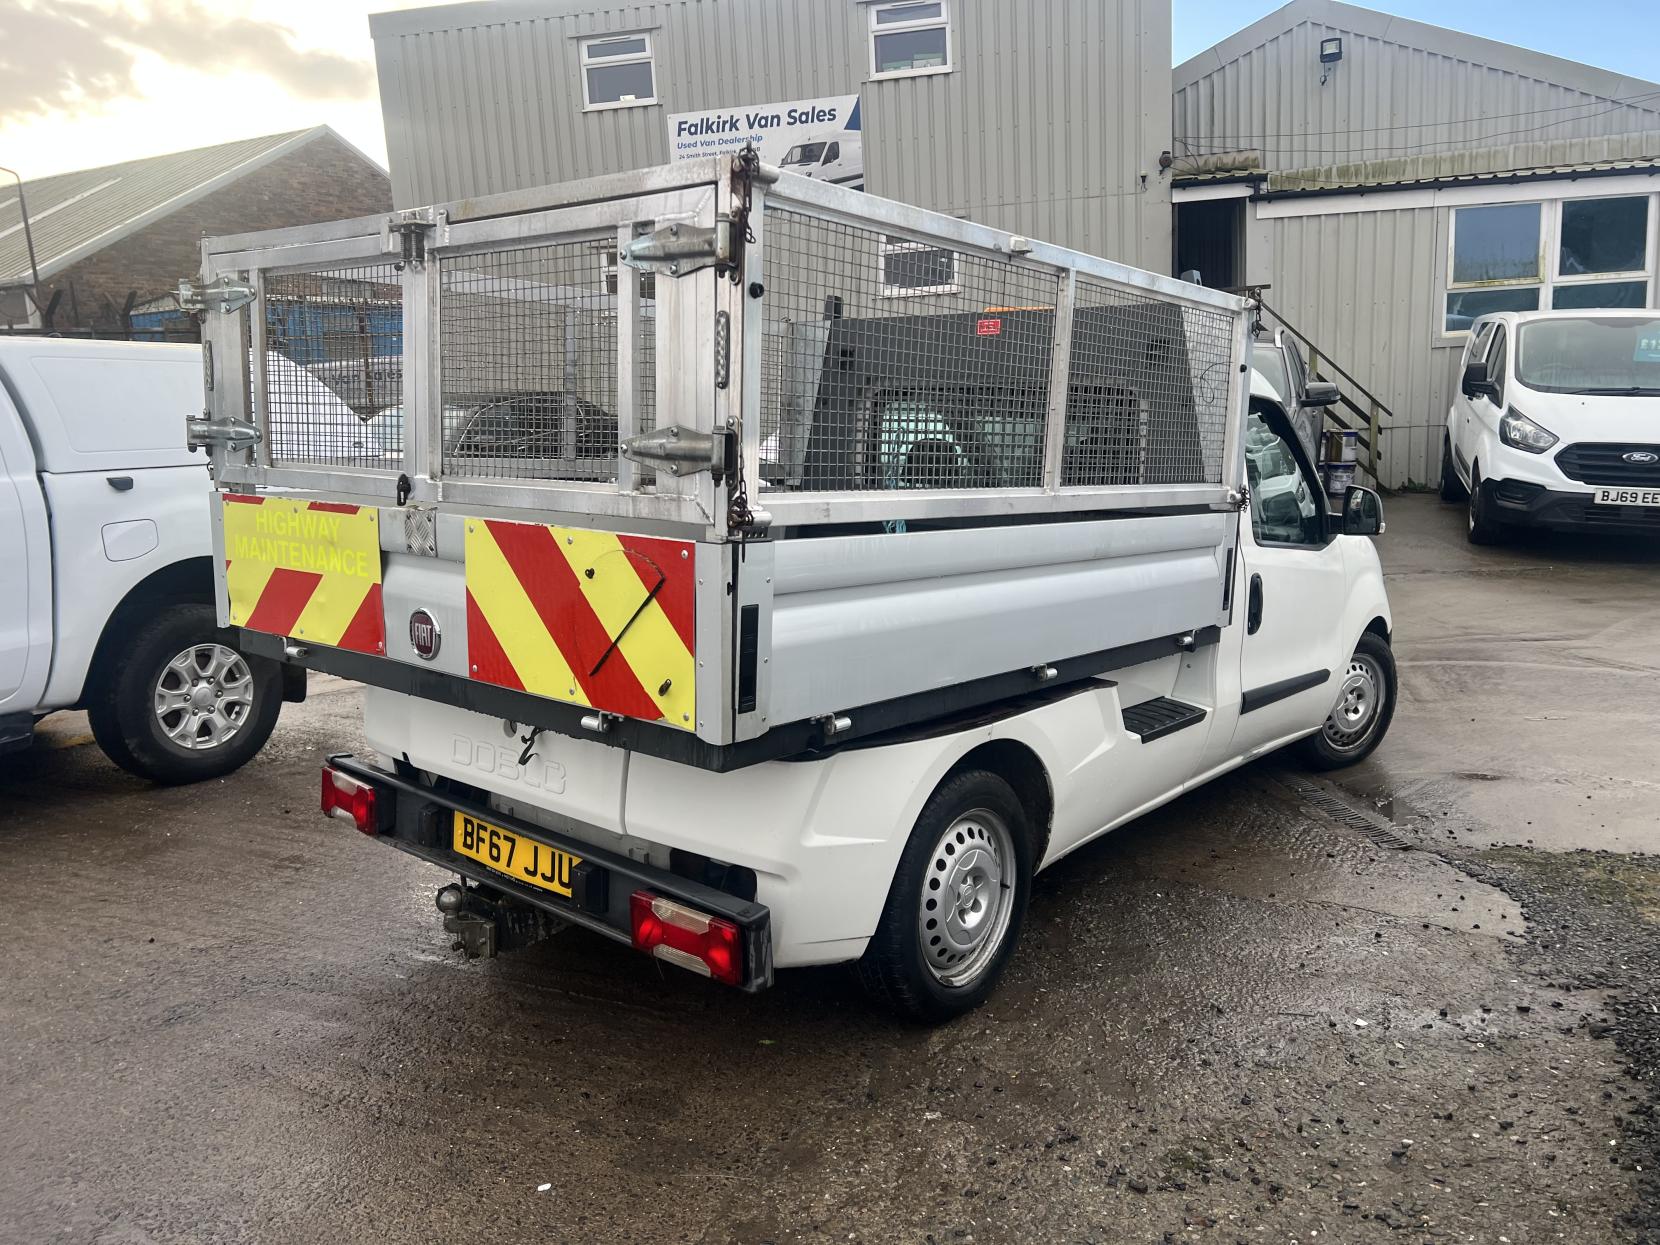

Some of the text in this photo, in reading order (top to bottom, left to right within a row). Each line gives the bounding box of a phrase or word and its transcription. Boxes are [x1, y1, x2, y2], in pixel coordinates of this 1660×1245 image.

[676, 106, 837, 138] Falkirk Van Sales
[677, 133, 763, 150] Used Van Dealership
[686, 152, 701, 160] Smith
[1601, 490, 1660, 504] BJ69 EE
[255, 508, 341, 543] HIGHWAY
[234, 533, 369, 578] MAINTENANCE
[414, 622, 432, 647] FIAT
[462, 816, 517, 869] BF67
[523, 845, 573, 890] JJU
